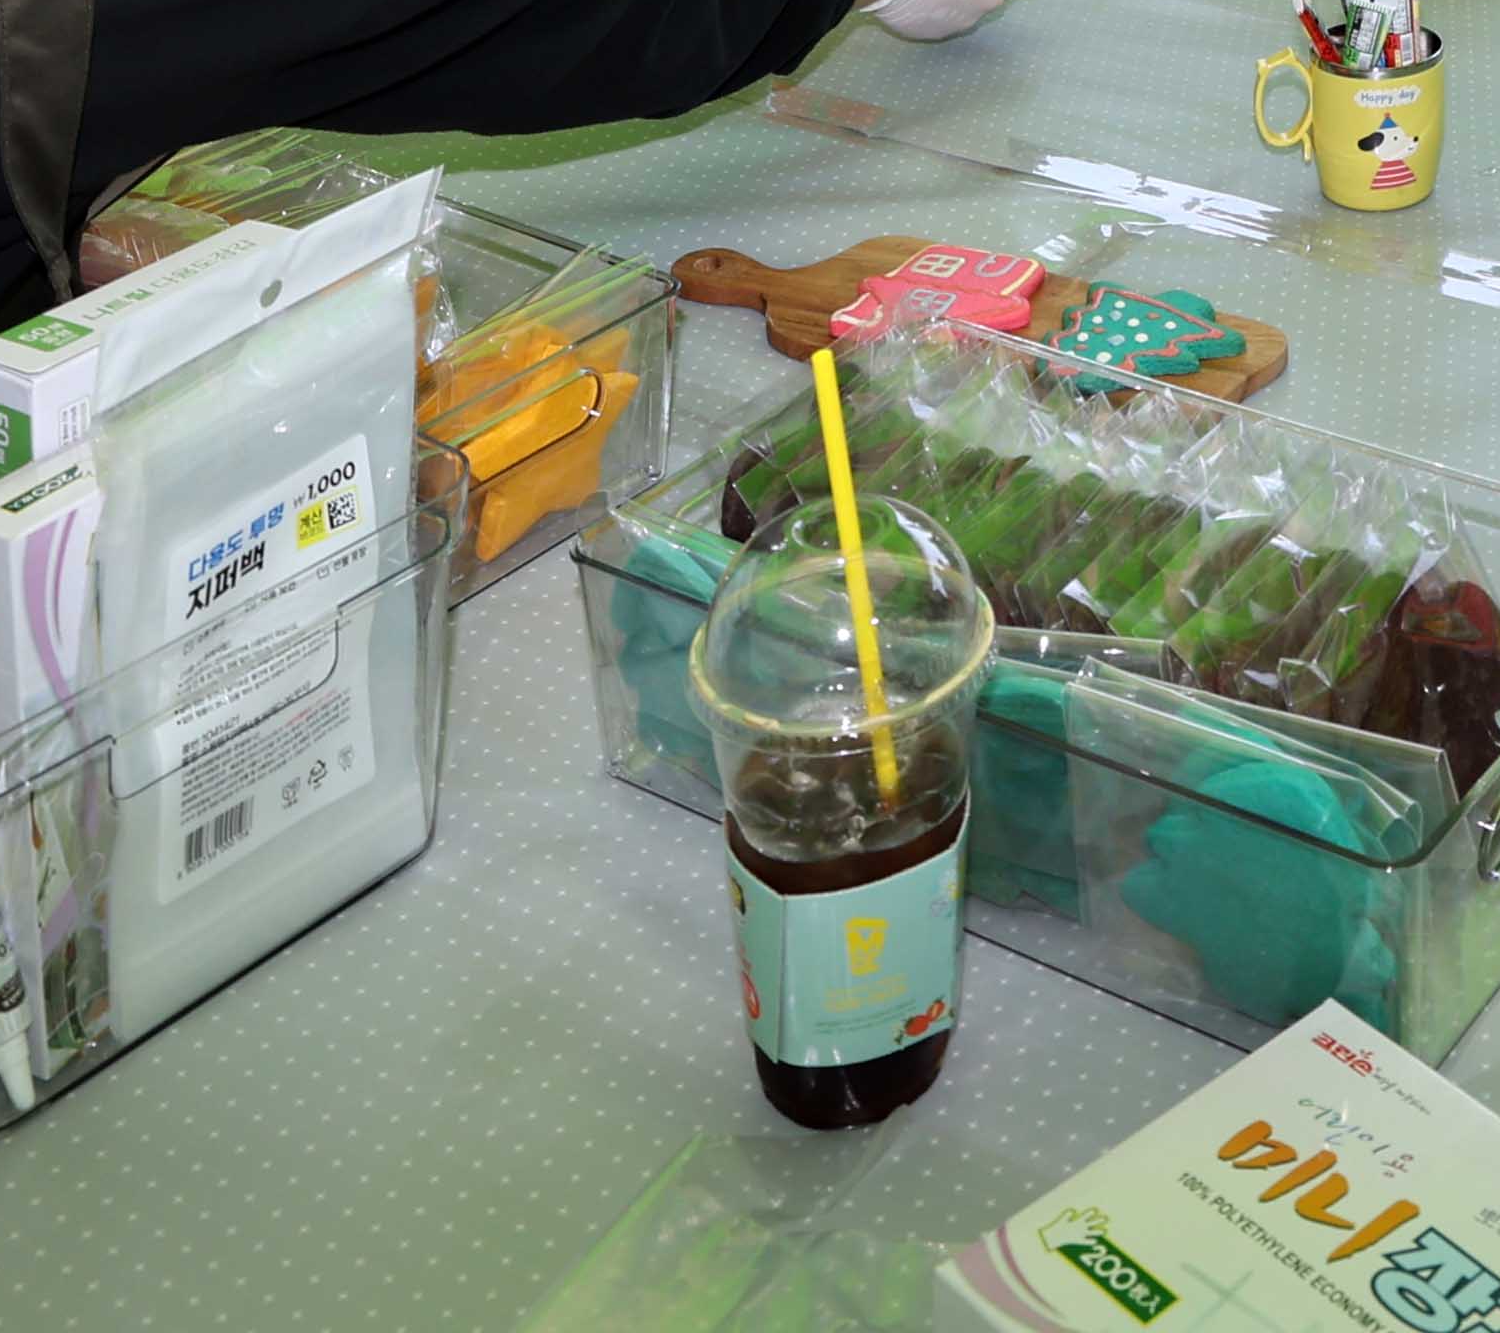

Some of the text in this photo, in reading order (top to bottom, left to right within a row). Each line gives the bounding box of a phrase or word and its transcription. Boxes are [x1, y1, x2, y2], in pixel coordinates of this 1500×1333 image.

[1360, 89, 1416, 106] Happy day
[186, 541, 266, 620] 지퍼백
[188, 502, 285, 582] 다용도 투명
[1216, 1119, 1421, 1265] 미니
[1177, 1171, 1383, 1333] 100% POLYETHYLENE ECONOMY
